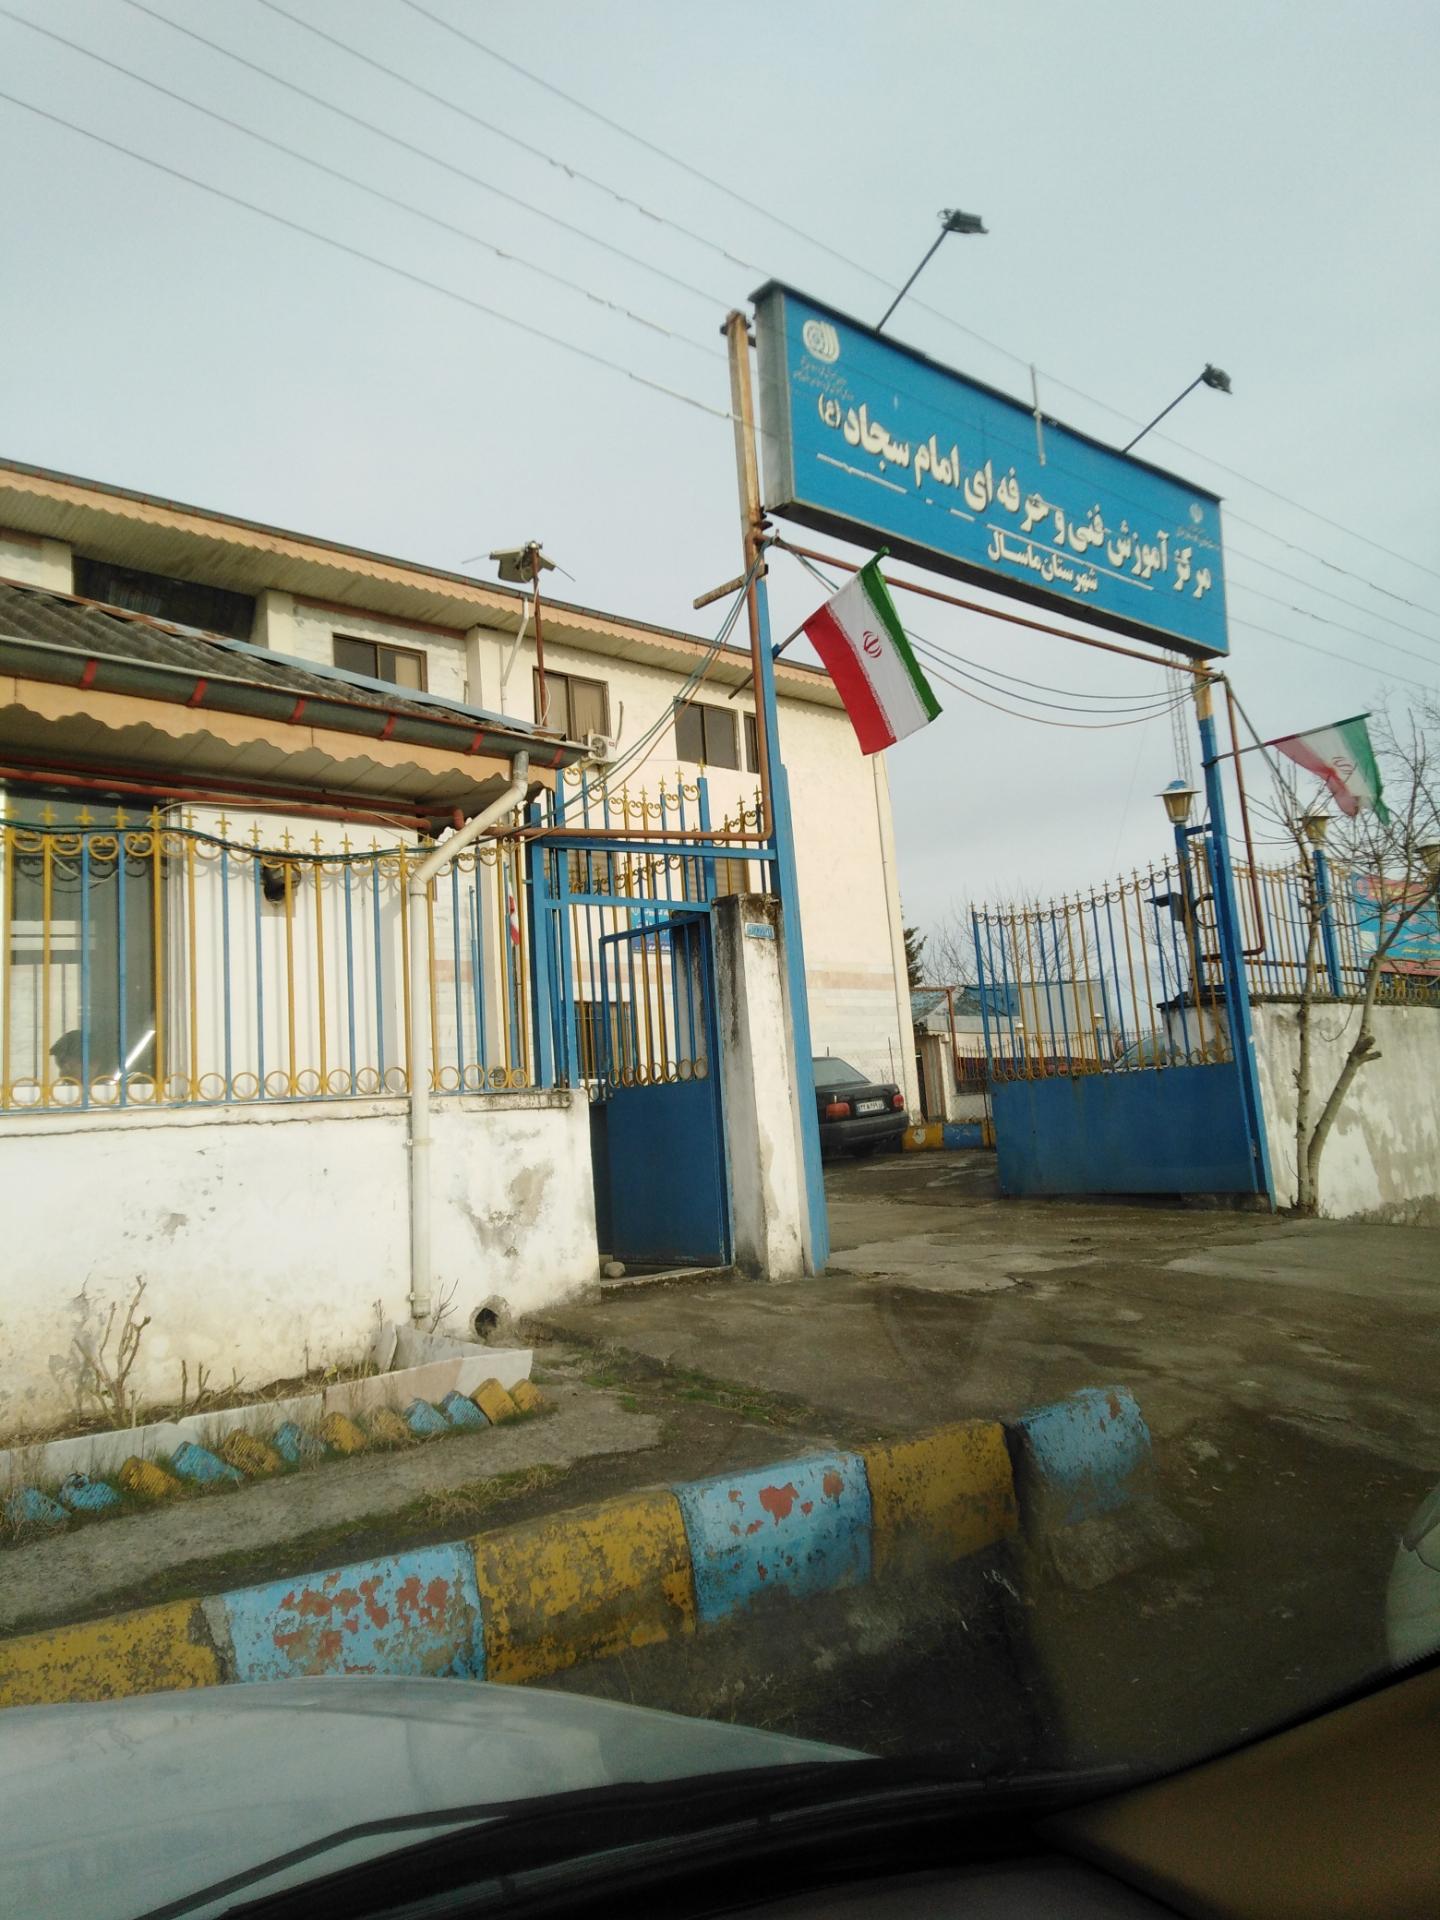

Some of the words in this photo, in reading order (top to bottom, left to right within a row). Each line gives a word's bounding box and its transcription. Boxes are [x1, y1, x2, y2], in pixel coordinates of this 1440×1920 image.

[817, 392, 841, 429] (ع)
[842, 403, 911, 472] سجاد
[913, 434, 960, 489] امام
[987, 529, 1041, 570] ماسال
[1052, 505, 1066, 545] و
[1068, 502, 1104, 552] فنی
[1108, 519, 1169, 579] آموزش
[1040, 554, 1098, 593] شهرستان
[1172, 547, 1212, 599] مرکز
